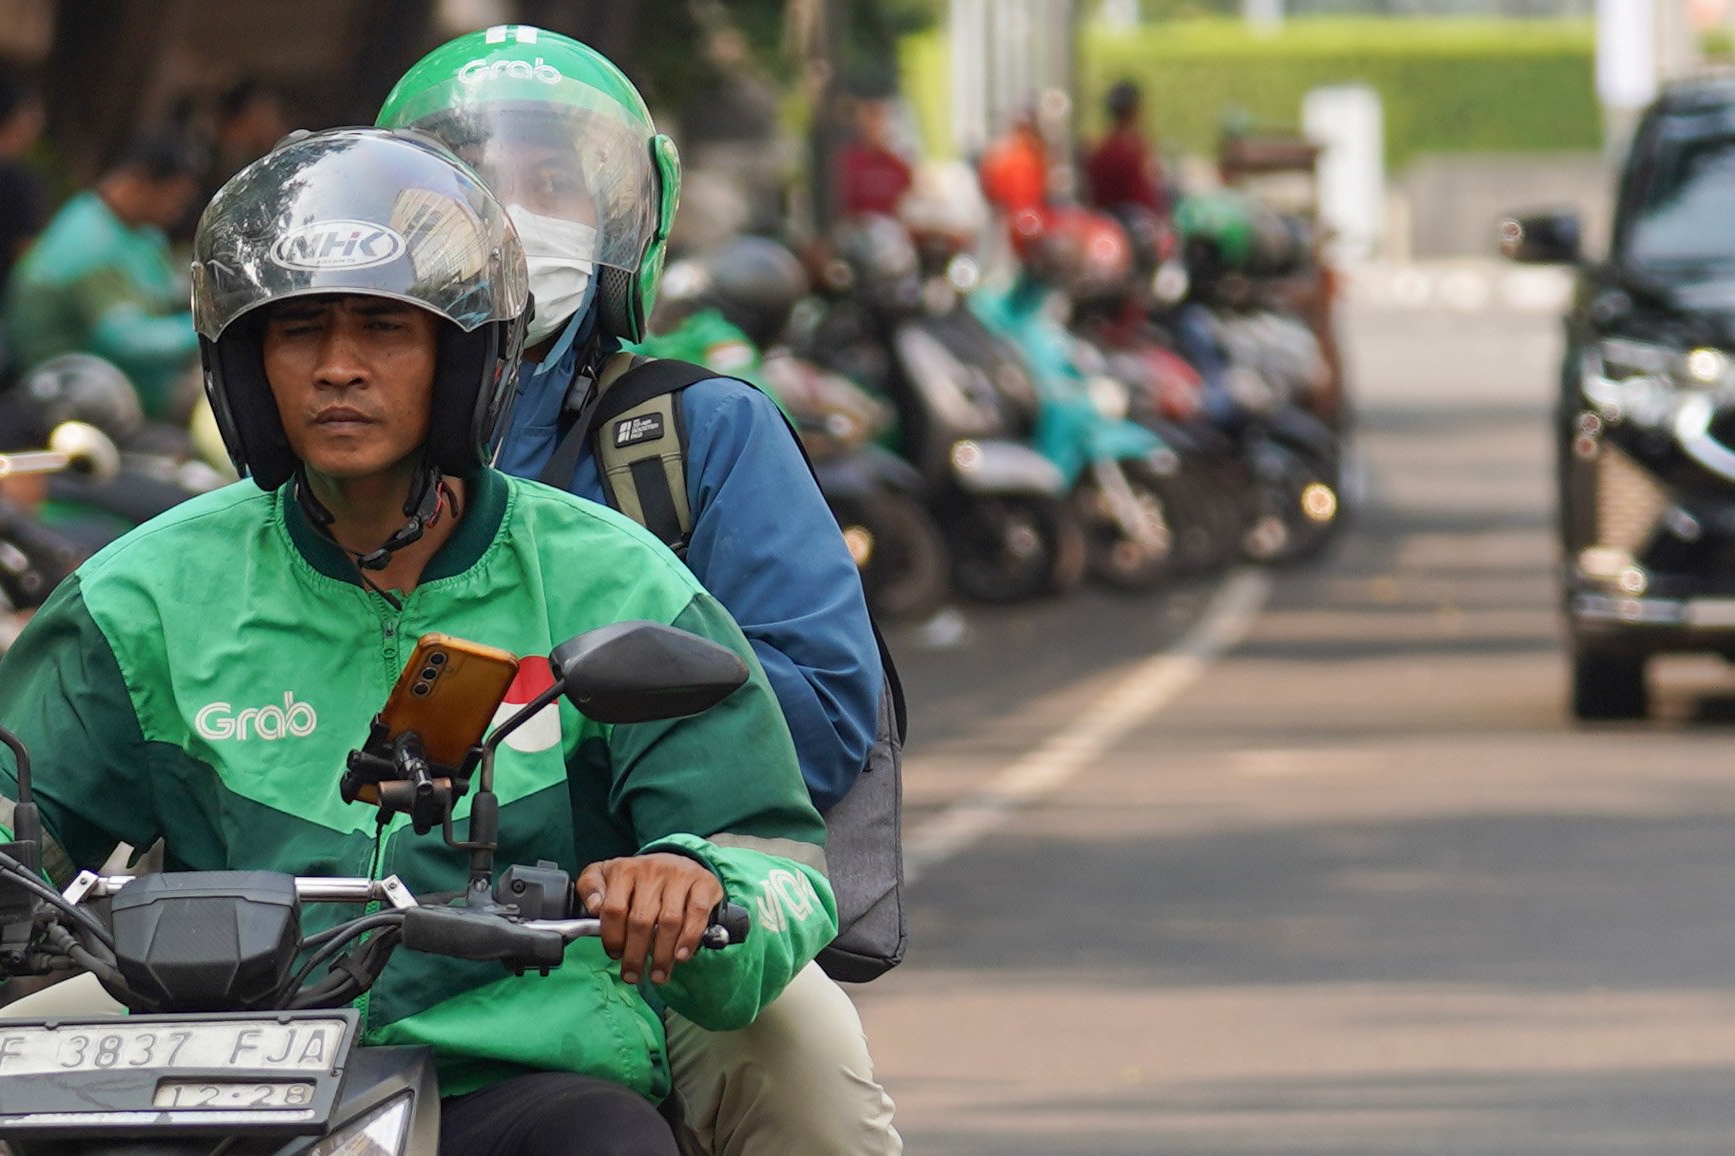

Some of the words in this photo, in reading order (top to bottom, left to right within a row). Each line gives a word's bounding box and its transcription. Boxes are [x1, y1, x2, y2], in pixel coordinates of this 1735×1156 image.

[458, 57, 562, 84] Grab
[286, 231, 387, 261] NHK
[195, 690, 317, 740] Grab
[61, 1031, 192, 1068] 3837
[229, 1029, 326, 1065] FJA
